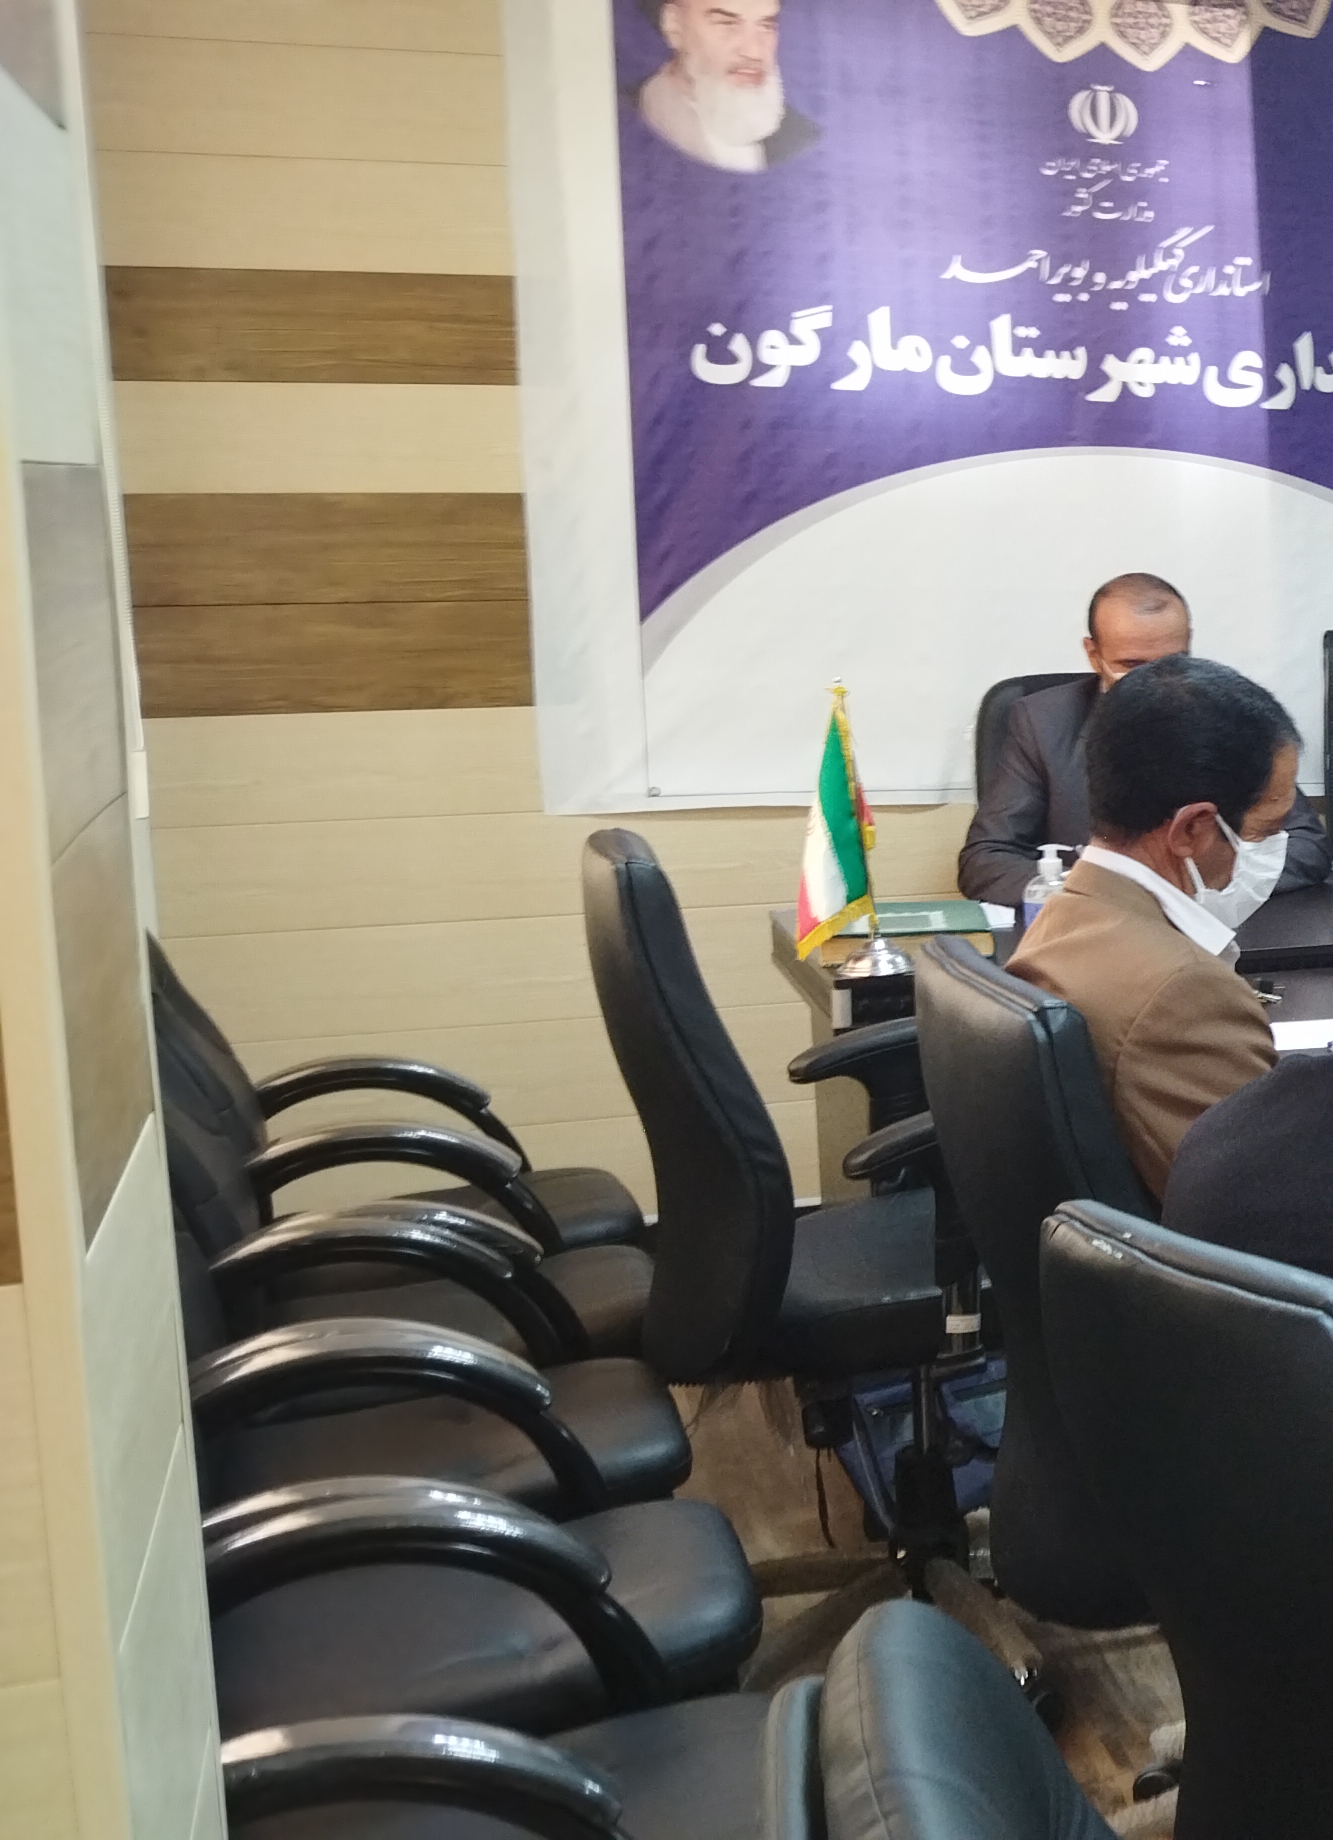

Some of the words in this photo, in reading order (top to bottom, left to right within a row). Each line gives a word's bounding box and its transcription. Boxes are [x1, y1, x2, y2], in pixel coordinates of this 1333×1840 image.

[1038, 157, 1081, 180] ایران
[1060, 178, 1114, 217] کشور
[1091, 201, 1155, 222] وزارت
[1162, 256, 1271, 303] استانداری
[690, 304, 934, 392] مارگون
[935, 313, 1202, 403] شهرستان
